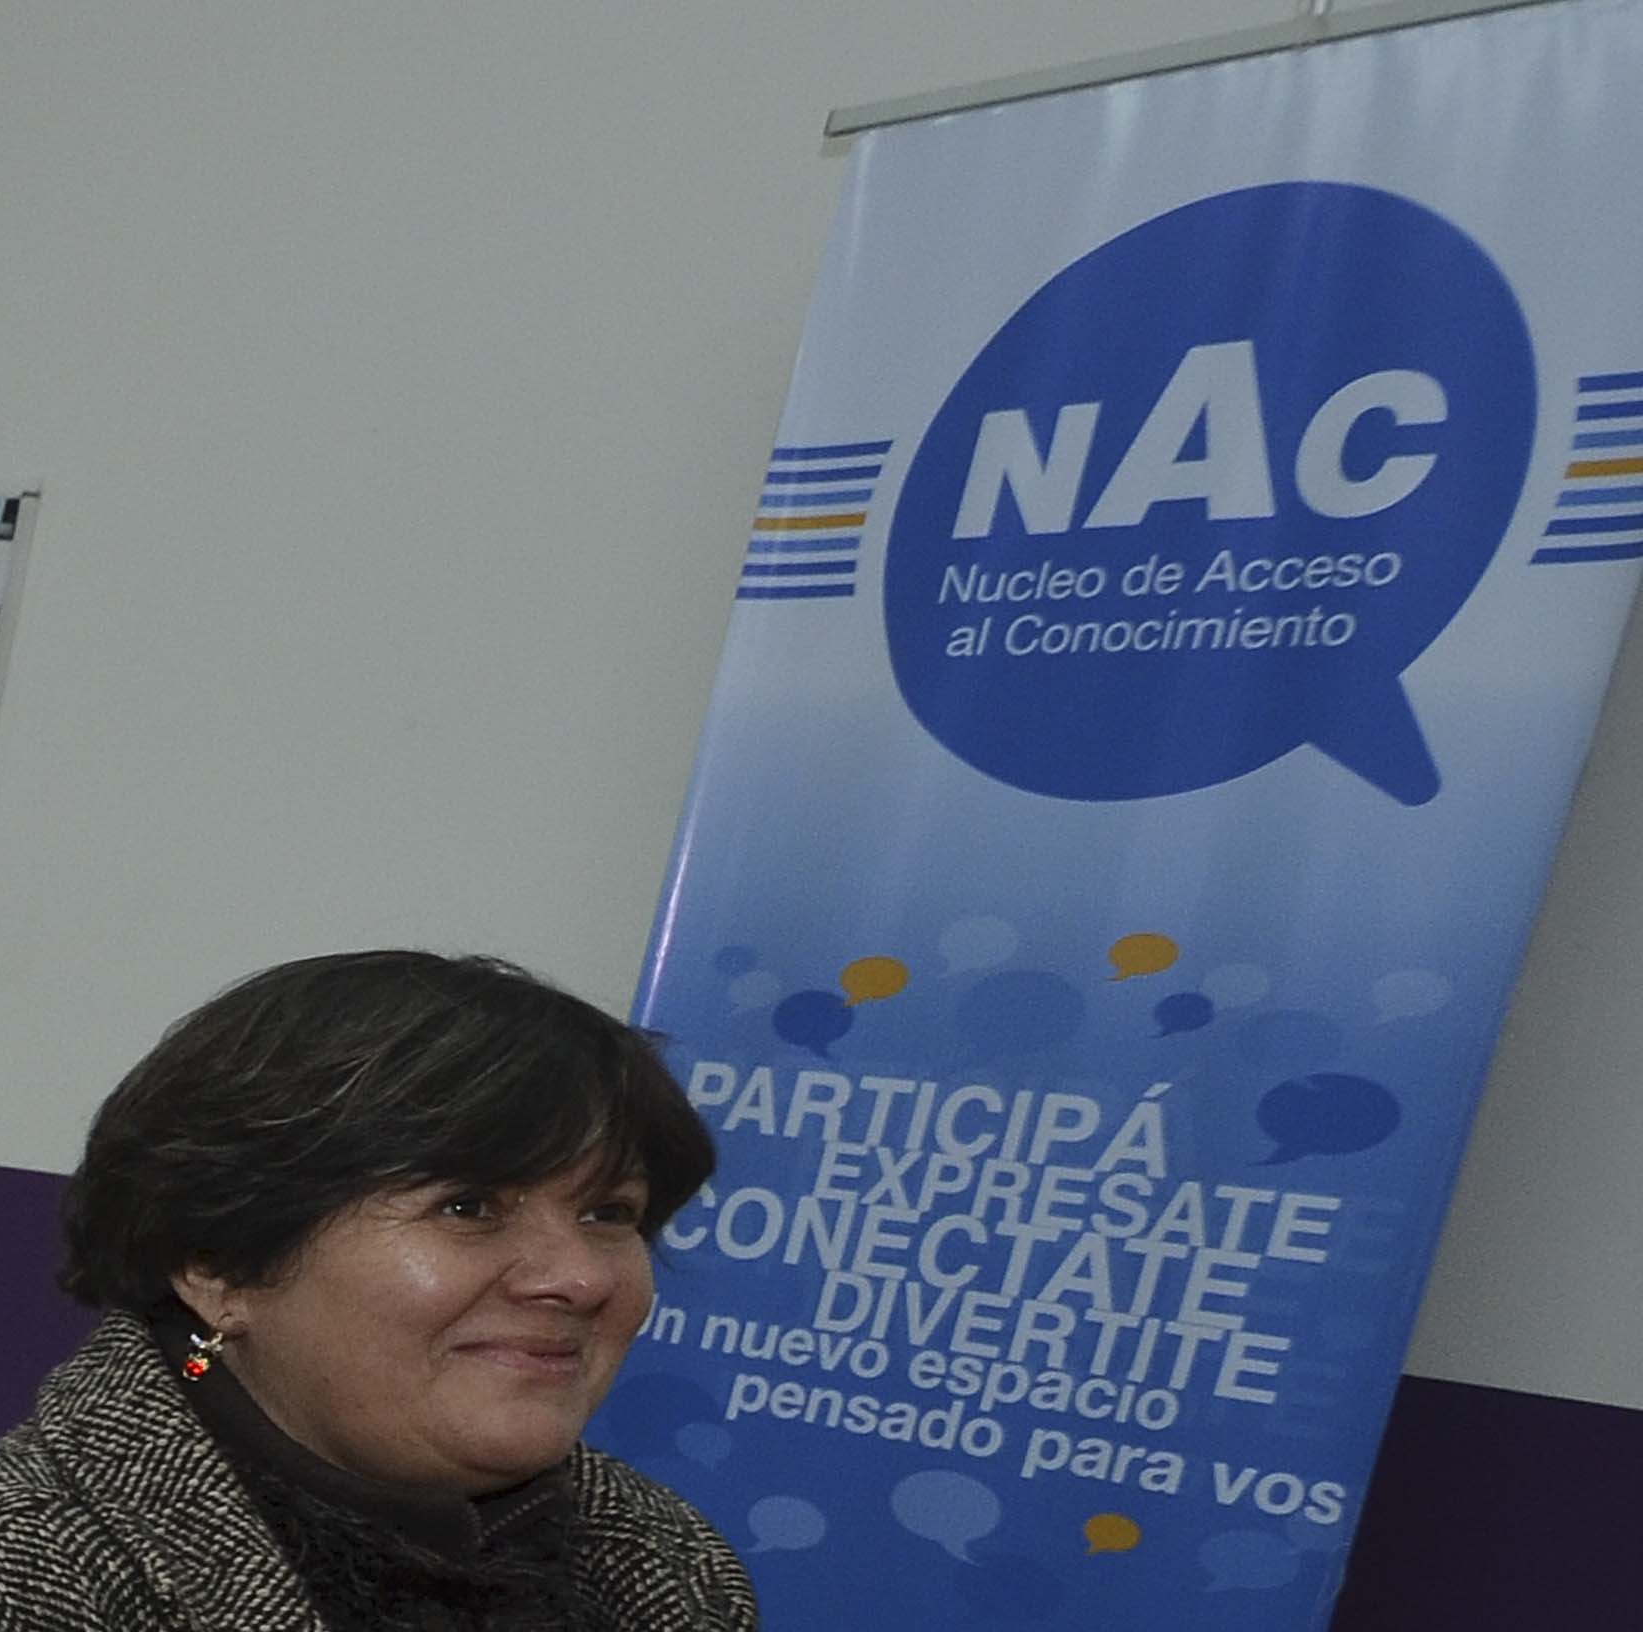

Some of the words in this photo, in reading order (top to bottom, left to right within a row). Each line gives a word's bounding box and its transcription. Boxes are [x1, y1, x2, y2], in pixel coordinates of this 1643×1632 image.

[952, 341, 1449, 539] NAC
[946, 618, 991, 657] al
[1005, 607, 1356, 656] Conocimiento
[1123, 555, 1185, 596] de
[1195, 550, 1402, 593] Acceso
[687, 1061, 1173, 1178] PARTICIPÁ
[816, 1139, 1342, 1264] EXPRESATE
[700, 1307, 889, 1380] nuevo
[907, 1348, 1180, 1431] espacio
[814, 1270, 1293, 1404] DIVERTITE
[724, 1373, 1004, 1458] pensado
[1021, 1427, 1185, 1495] para
[1213, 1462, 1348, 1525] vos
